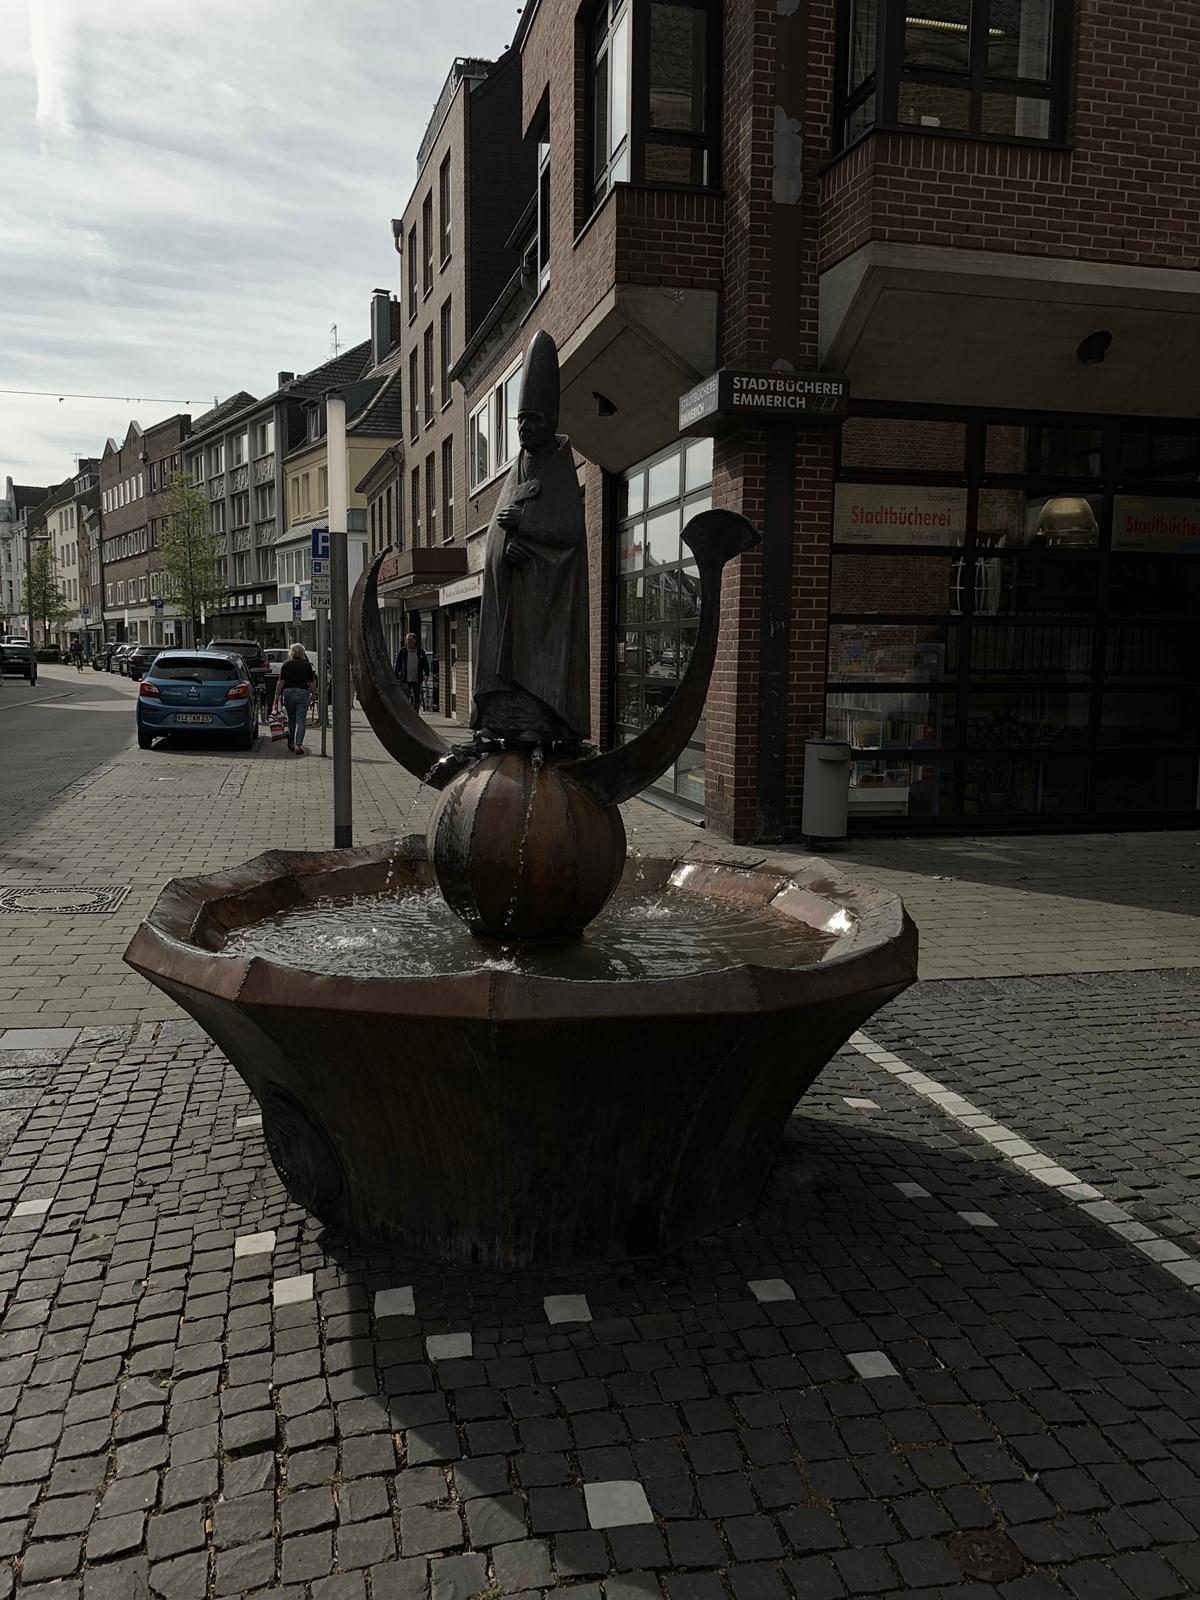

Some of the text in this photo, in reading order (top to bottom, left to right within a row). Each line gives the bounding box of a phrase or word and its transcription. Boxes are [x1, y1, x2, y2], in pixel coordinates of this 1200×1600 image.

[732, 376, 843, 395] STADTBÜCHEREI
[732, 392, 806, 409] EMMERICH
[849, 505, 951, 527] Stadtbücherei
[294, 598, 300, 609] P
